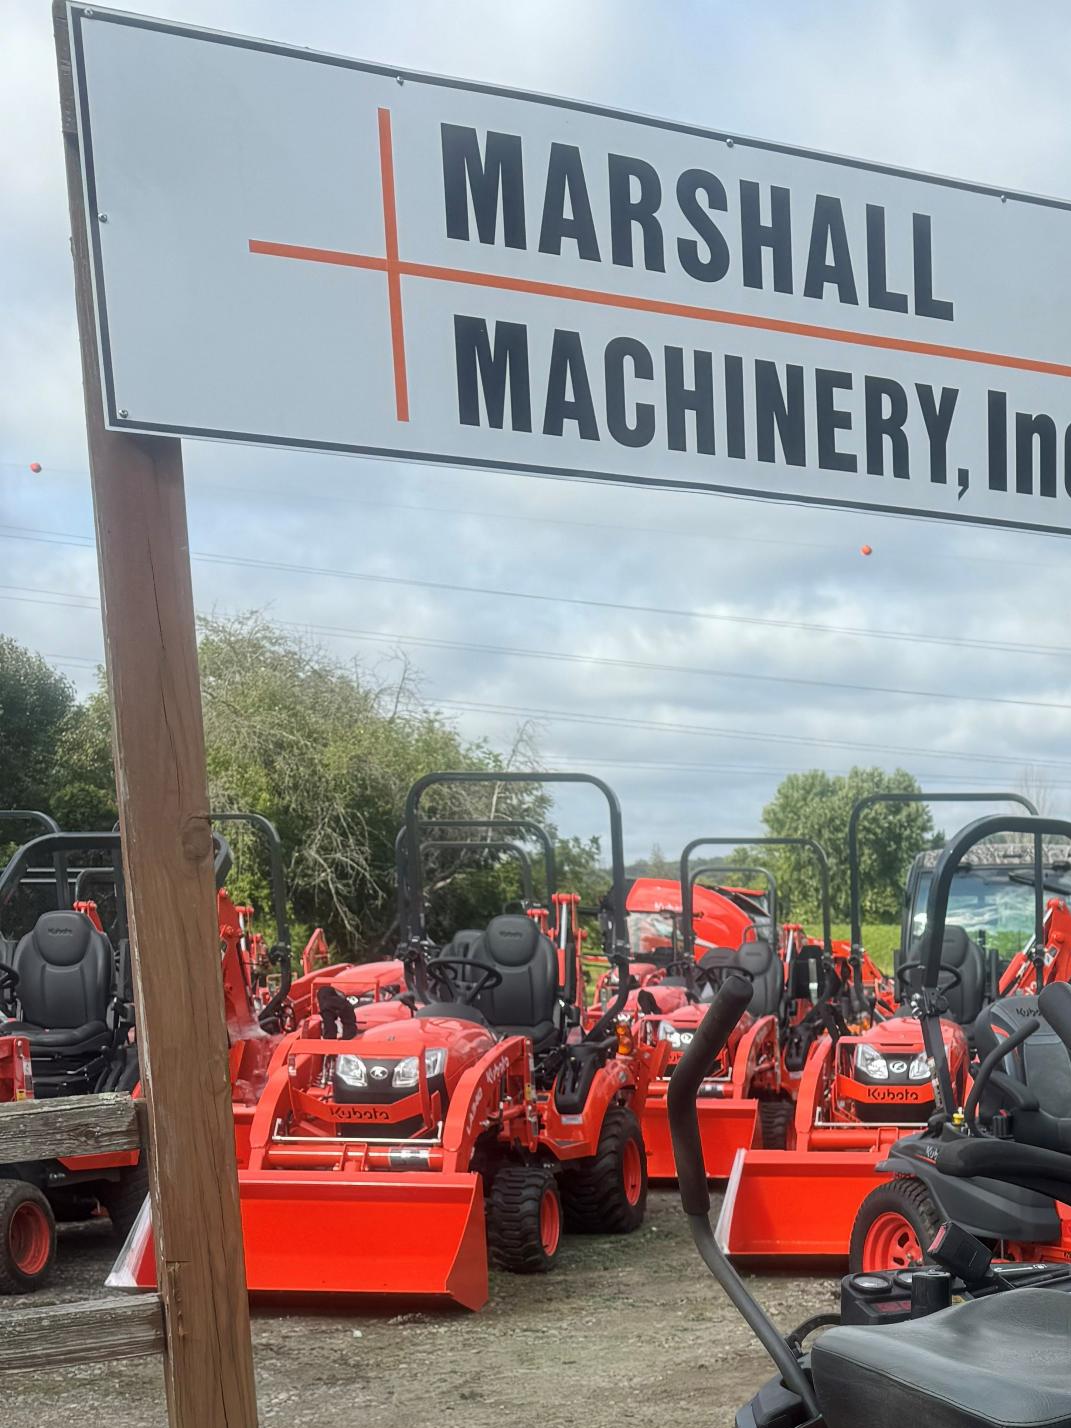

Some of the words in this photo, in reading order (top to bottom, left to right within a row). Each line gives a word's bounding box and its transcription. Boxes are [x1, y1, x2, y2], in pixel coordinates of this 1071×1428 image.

[440, 122, 954, 321] MARSHALL
[453, 314, 969, 501] MACHINERY,
[330, 1106, 389, 1120] Kubota
[867, 1087, 919, 1101] Kubota
